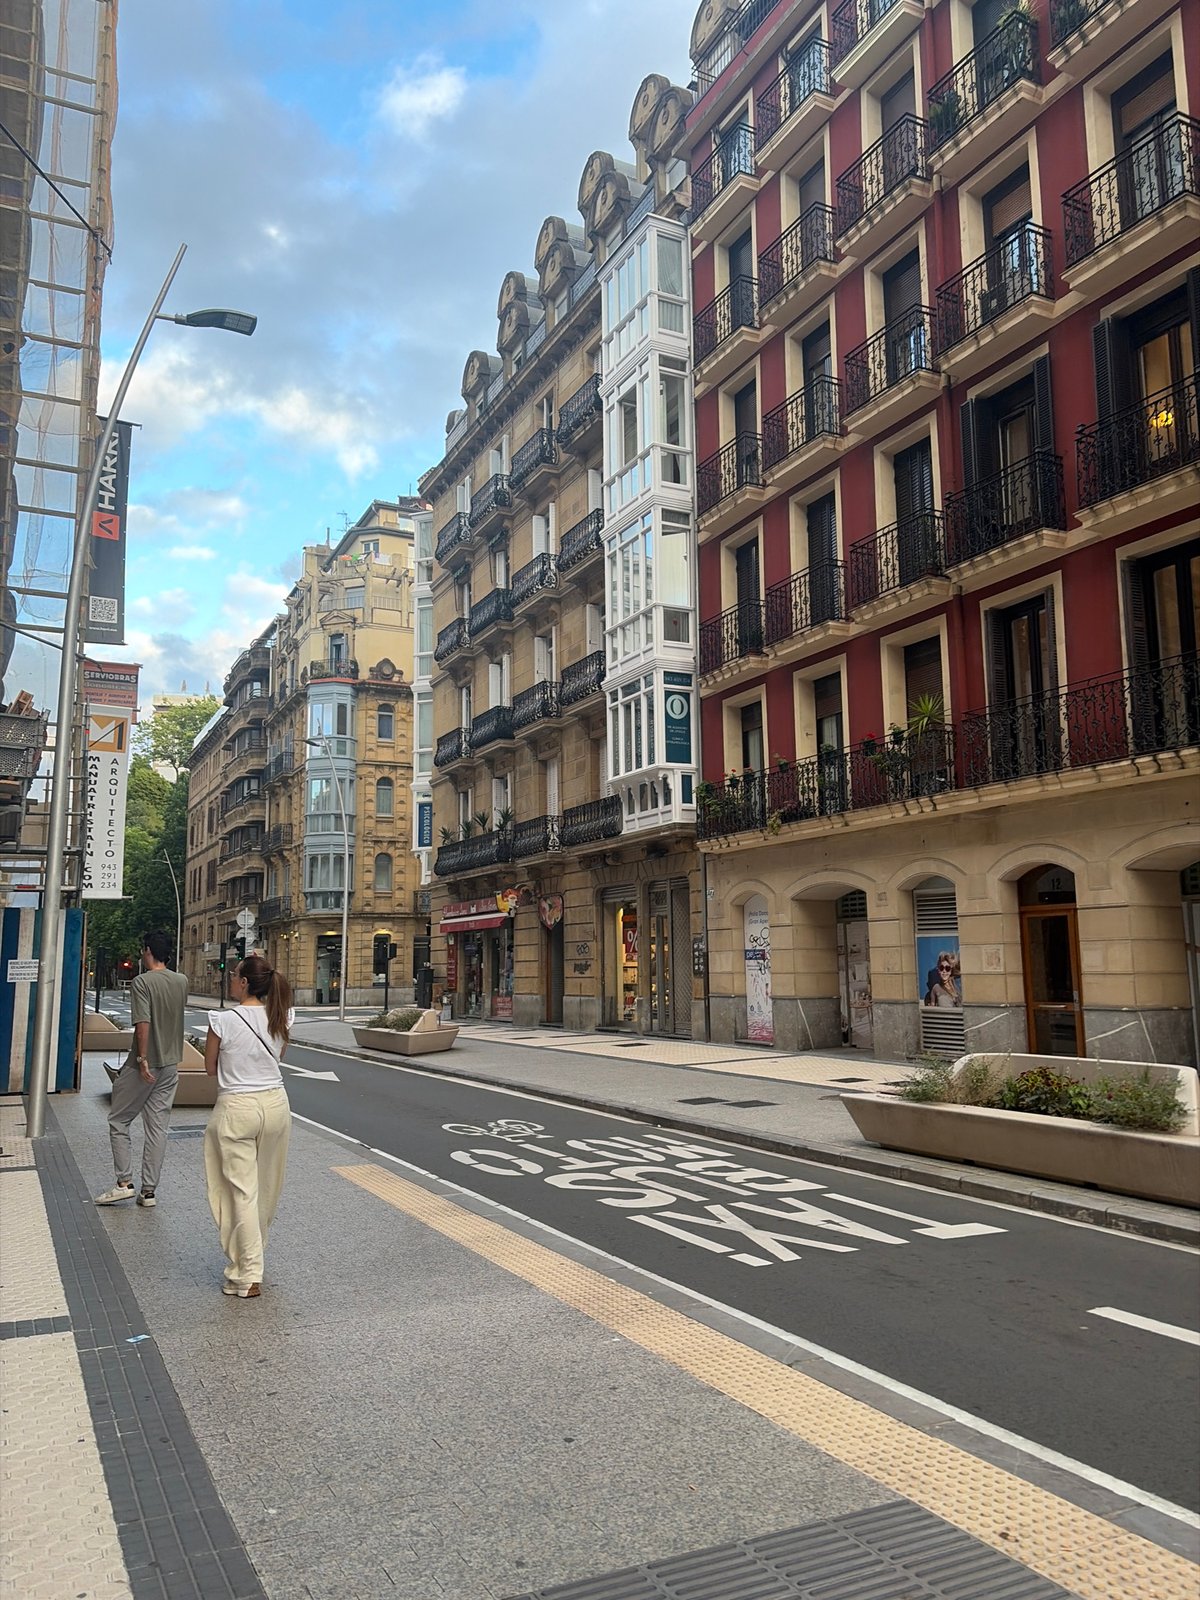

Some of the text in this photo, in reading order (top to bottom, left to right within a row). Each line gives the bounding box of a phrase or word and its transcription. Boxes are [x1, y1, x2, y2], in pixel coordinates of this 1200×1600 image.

[84, 671, 137, 683] SERVIOBRAS
[105, 758, 119, 858] ARQUITECTO
[1051, 877, 1063, 890] 12
[450, 1133, 735, 1176] MOTO
[544, 1159, 829, 1209] BUS
[627, 1193, 1009, 1267] TAXI
